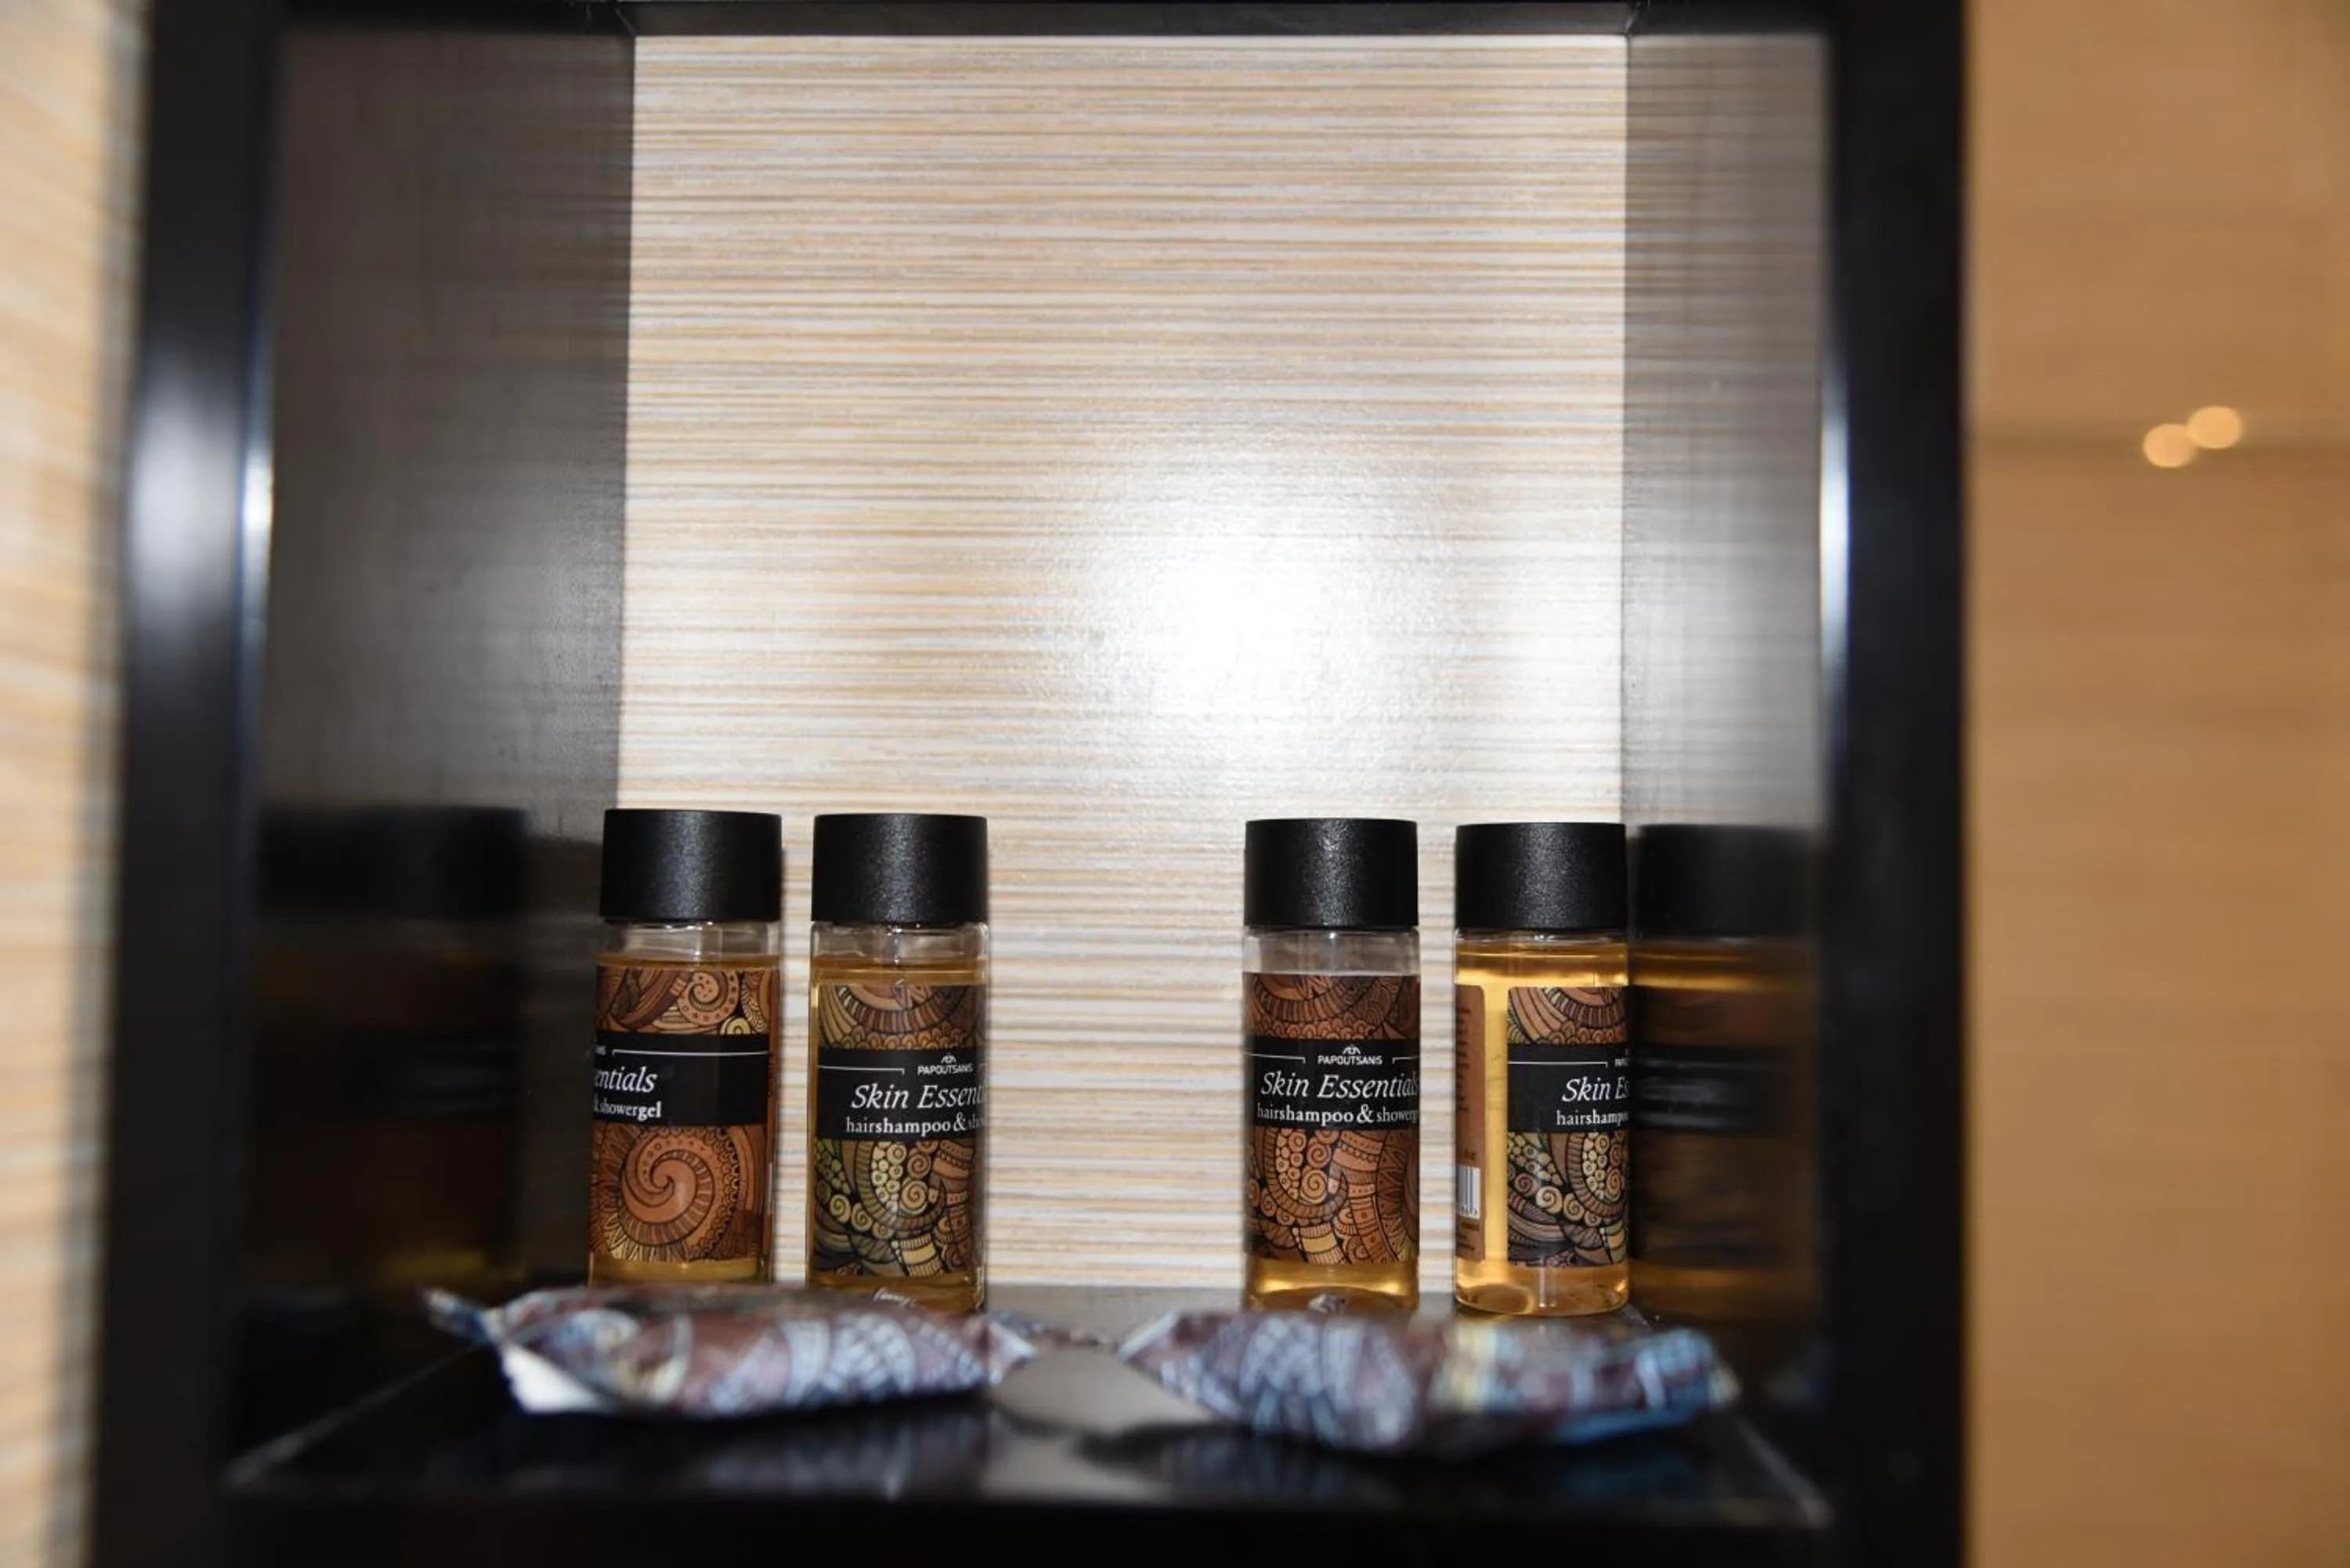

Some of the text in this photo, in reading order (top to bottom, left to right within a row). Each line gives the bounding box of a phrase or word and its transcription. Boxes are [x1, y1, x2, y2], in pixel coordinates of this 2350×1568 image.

[917, 1063, 973, 1076] PAPOUTSANIS
[1317, 1055, 1383, 1066] PAPOUTSANIS
[851, 1082, 909, 1109] Skin
[1260, 1070, 1310, 1097] Skin
[1561, 1076, 1611, 1102] Skin
[845, 1116, 951, 1136] hairshampoo
[1256, 1102, 1354, 1126] hairshampoo
[1356, 1104, 1374, 1124] &
